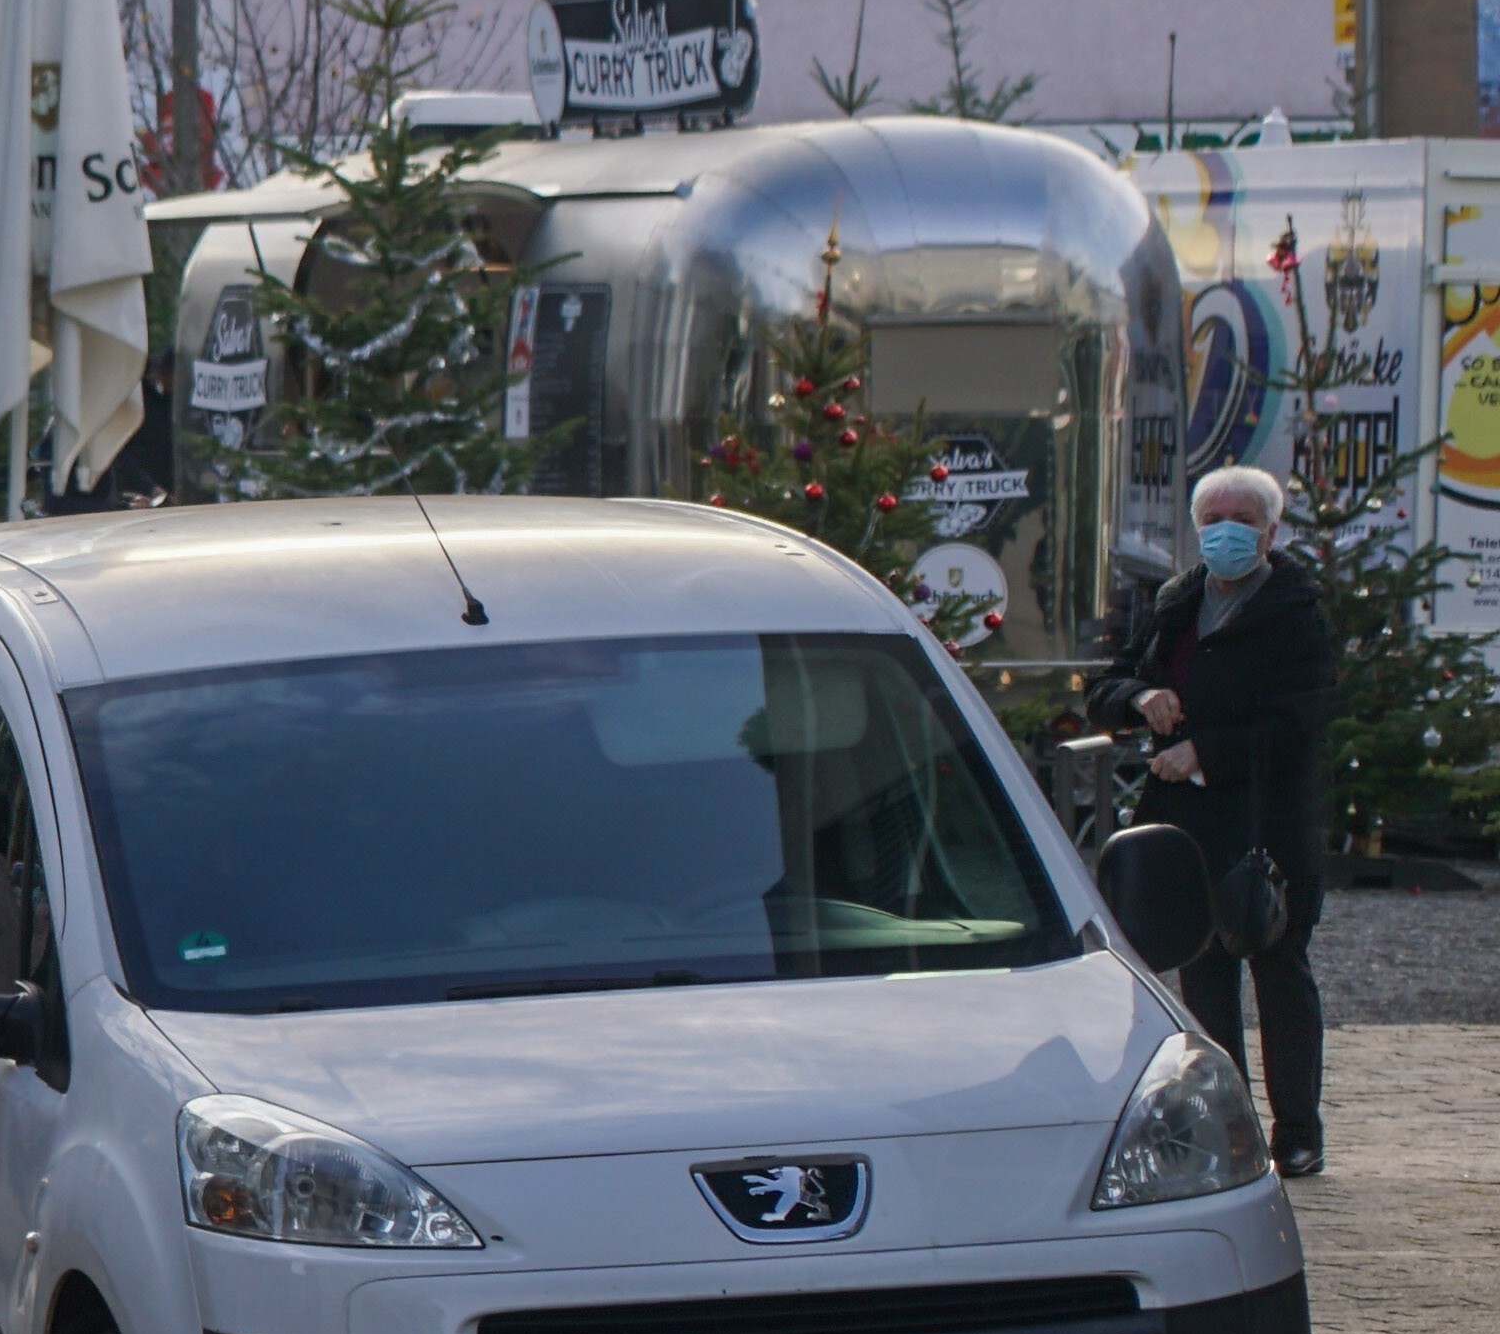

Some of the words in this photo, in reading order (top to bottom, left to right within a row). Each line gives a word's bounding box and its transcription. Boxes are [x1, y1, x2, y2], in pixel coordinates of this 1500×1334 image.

[573, 49, 636, 98] CURRY
[643, 40, 710, 96] TRUCK
[197, 373, 228, 400] CURRY
[963, 477, 1024, 495] TRUCK
